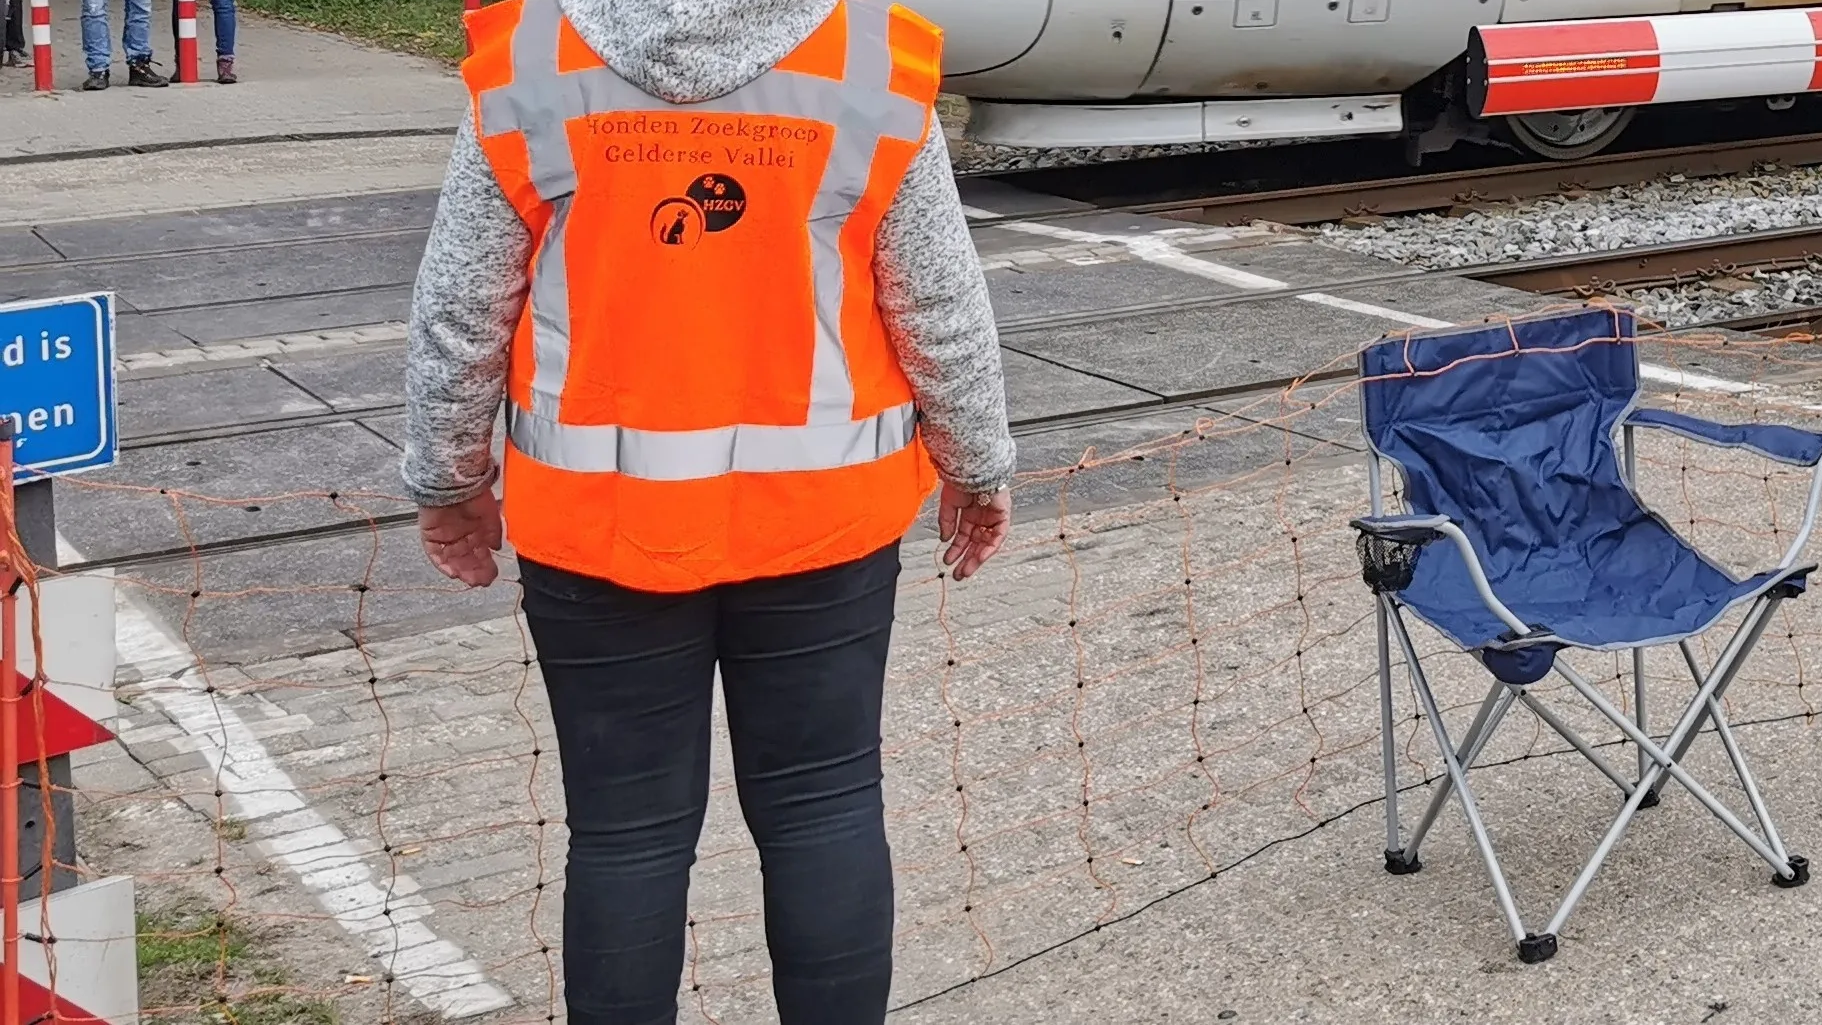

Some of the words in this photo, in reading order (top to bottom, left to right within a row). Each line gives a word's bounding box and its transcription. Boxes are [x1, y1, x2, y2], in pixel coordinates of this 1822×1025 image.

[604, 143, 713, 164] Gelderse
[724, 146, 796, 169] Vallei
[40, 330, 72, 362] is
